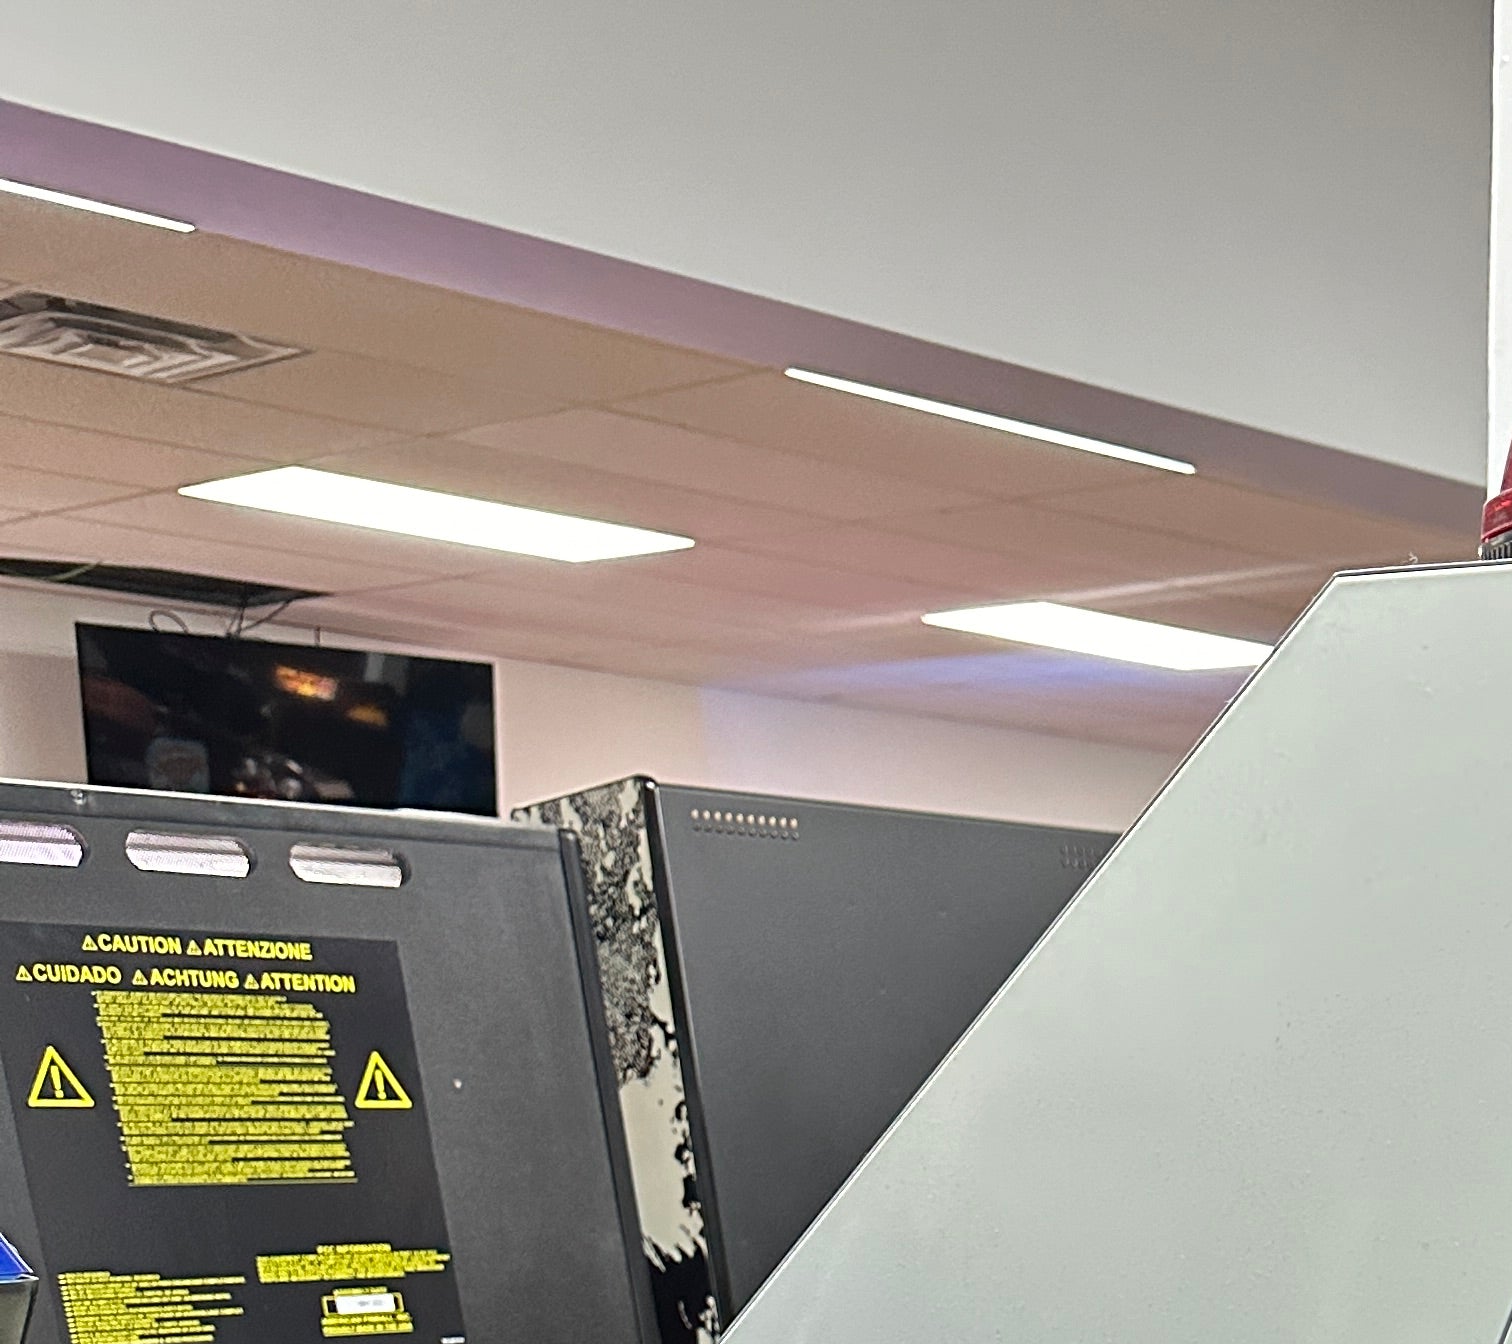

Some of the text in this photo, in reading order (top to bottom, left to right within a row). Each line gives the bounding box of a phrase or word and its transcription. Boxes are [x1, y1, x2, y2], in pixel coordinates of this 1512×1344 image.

[97, 934, 313, 961] CAUTION ATTENZIONE
[33, 963, 356, 994] CUIDADO ACHTUNG ATTENTION
